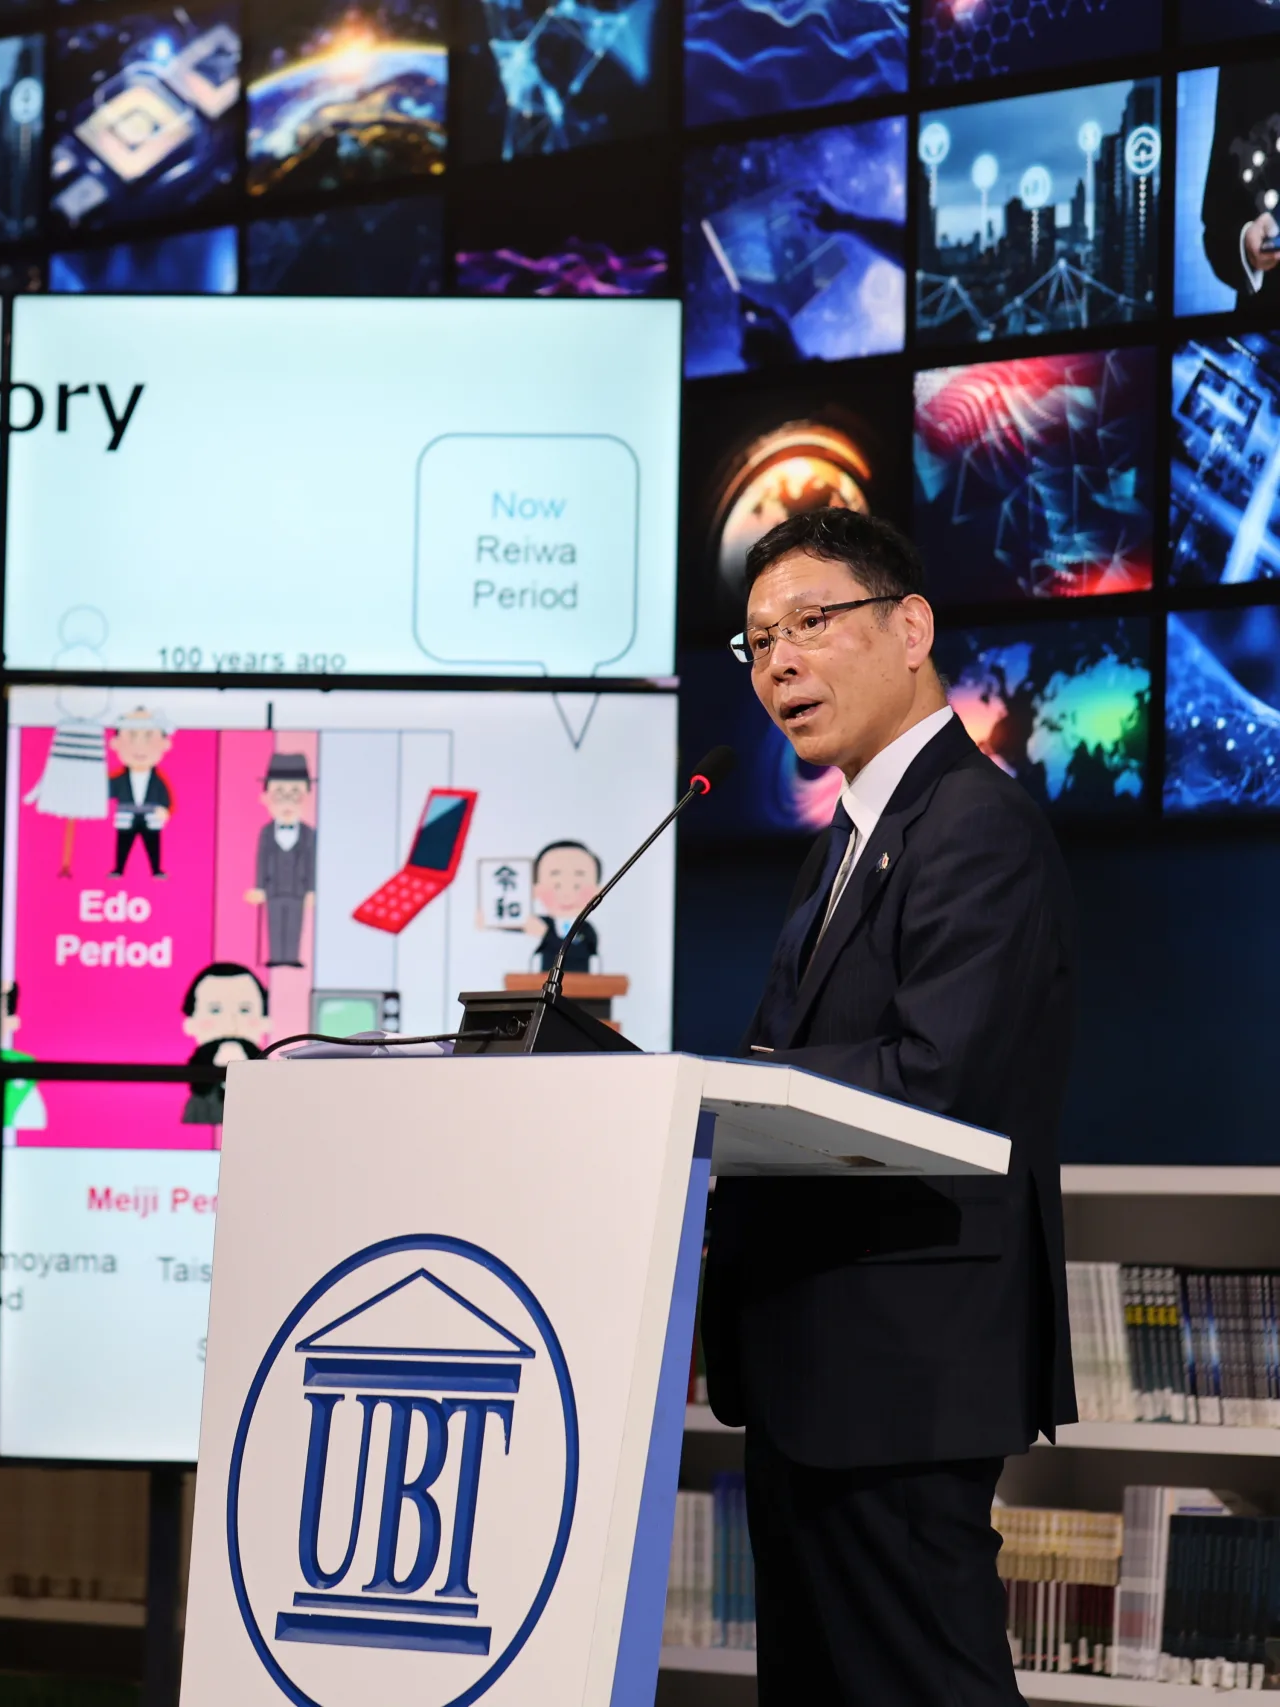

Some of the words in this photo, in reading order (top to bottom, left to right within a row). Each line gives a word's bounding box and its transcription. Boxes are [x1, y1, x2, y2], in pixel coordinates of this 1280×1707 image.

[491, 491, 568, 520] Now
[476, 536, 578, 566] Reiwa
[474, 581, 579, 610] Period
[158, 646, 202, 671] 100
[212, 651, 284, 685] years
[79, 889, 151, 923] Edo
[493, 864, 522, 920] 令和
[56, 934, 173, 968] Period
[87, 1186, 159, 1218] Meiji
[171, 1187, 218, 1213] Per
[157, 1256, 213, 1283] Tais
[298, 1393, 515, 1598] UBT
